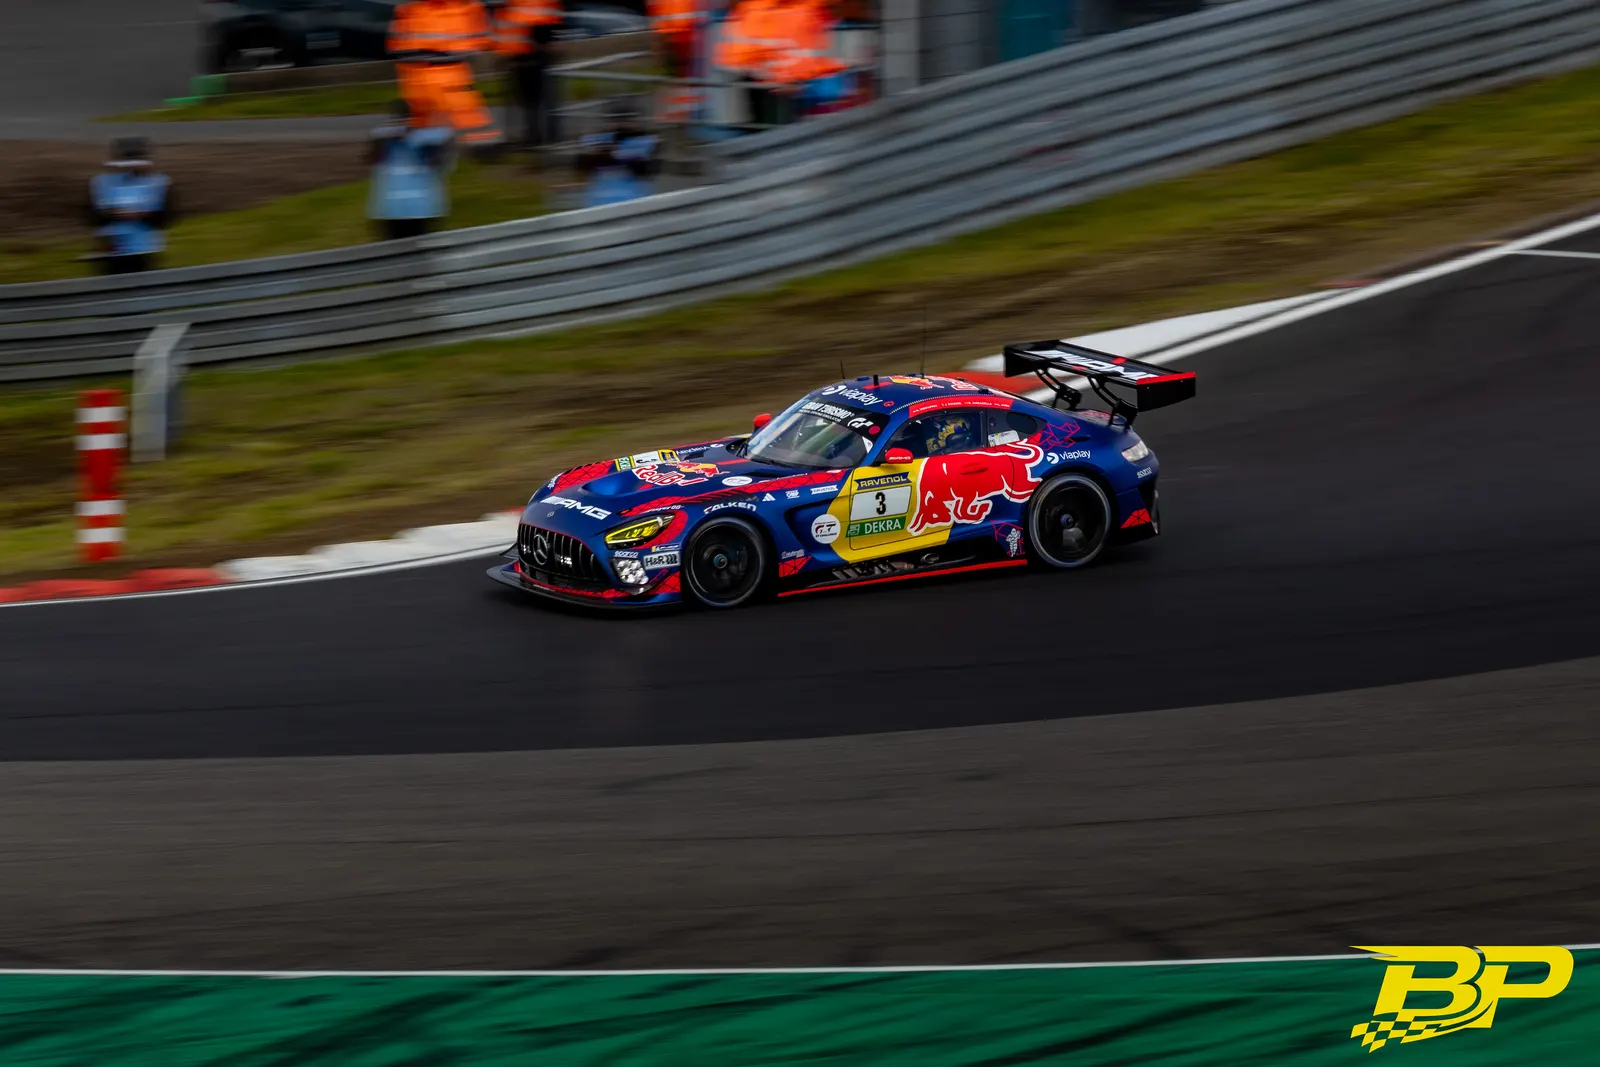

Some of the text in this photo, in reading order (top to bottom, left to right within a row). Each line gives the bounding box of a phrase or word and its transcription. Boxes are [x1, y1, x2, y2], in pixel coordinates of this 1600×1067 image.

[838, 388, 883, 406] viaplay
[1060, 449, 1091, 460] viaplay
[859, 475, 907, 488] RAVENOL
[550, 495, 612, 521] AMG
[703, 501, 757, 515] FALKEN
[875, 491, 887, 515] 3
[864, 518, 902, 535] DEKRA
